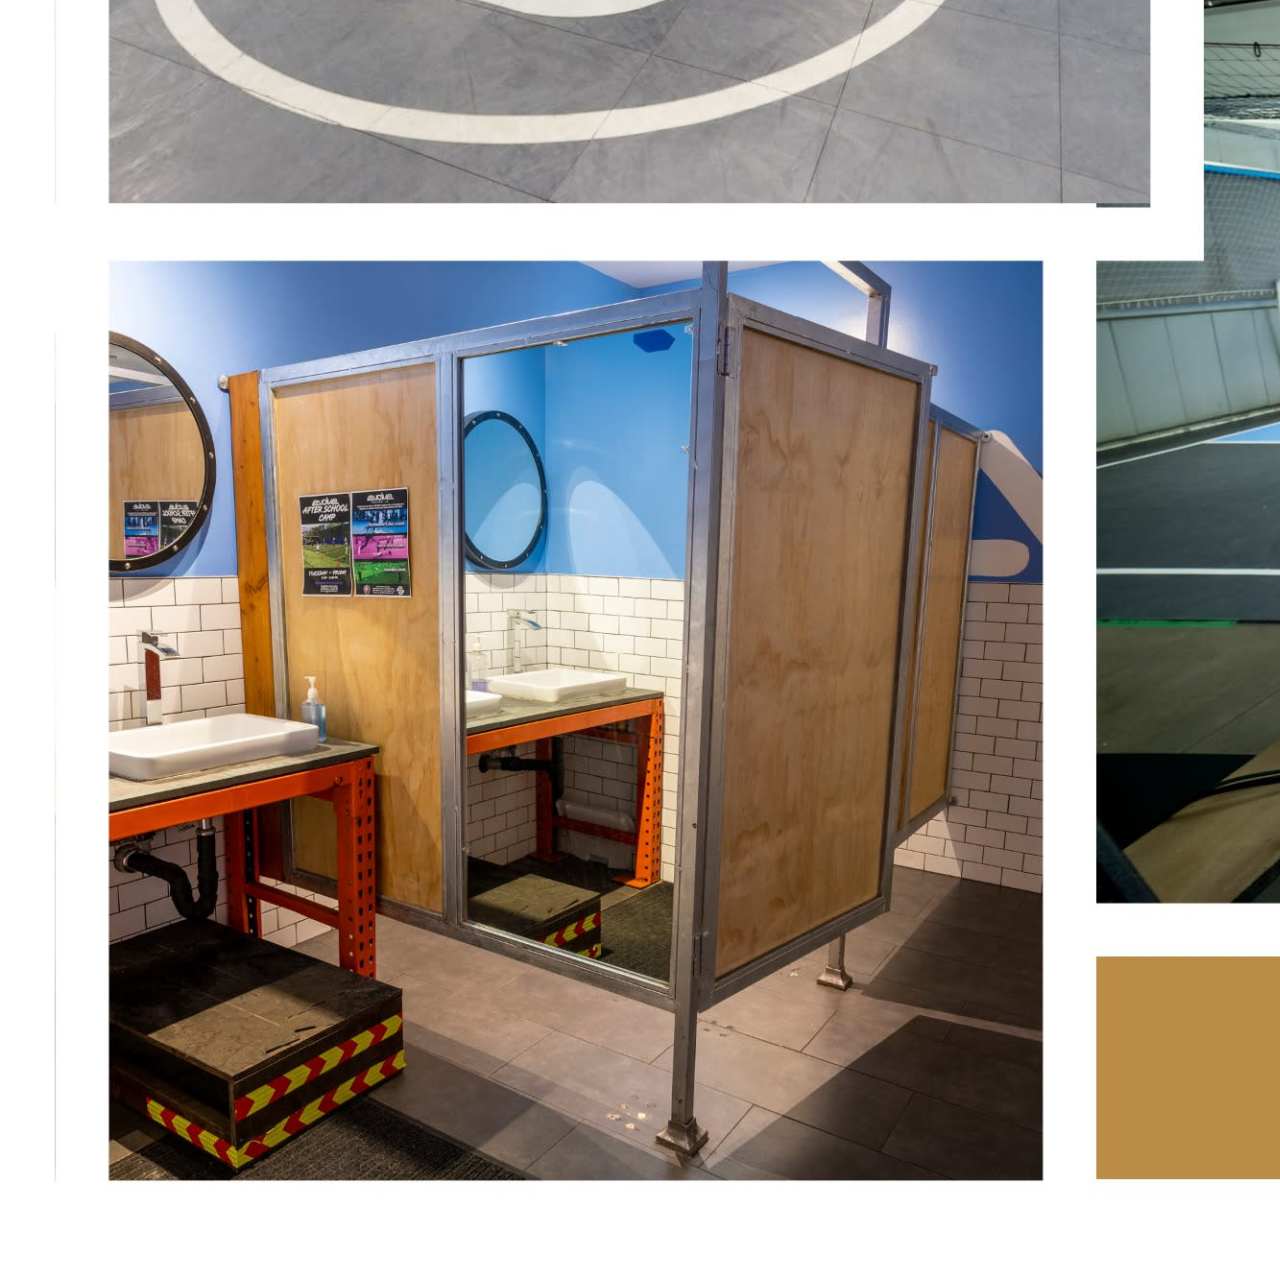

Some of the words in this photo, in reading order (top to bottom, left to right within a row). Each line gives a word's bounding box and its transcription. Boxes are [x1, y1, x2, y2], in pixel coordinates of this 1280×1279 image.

[302, 505, 323, 514] AFTER
[323, 504, 349, 513] SCHOOL
[318, 513, 336, 521] CAMP
